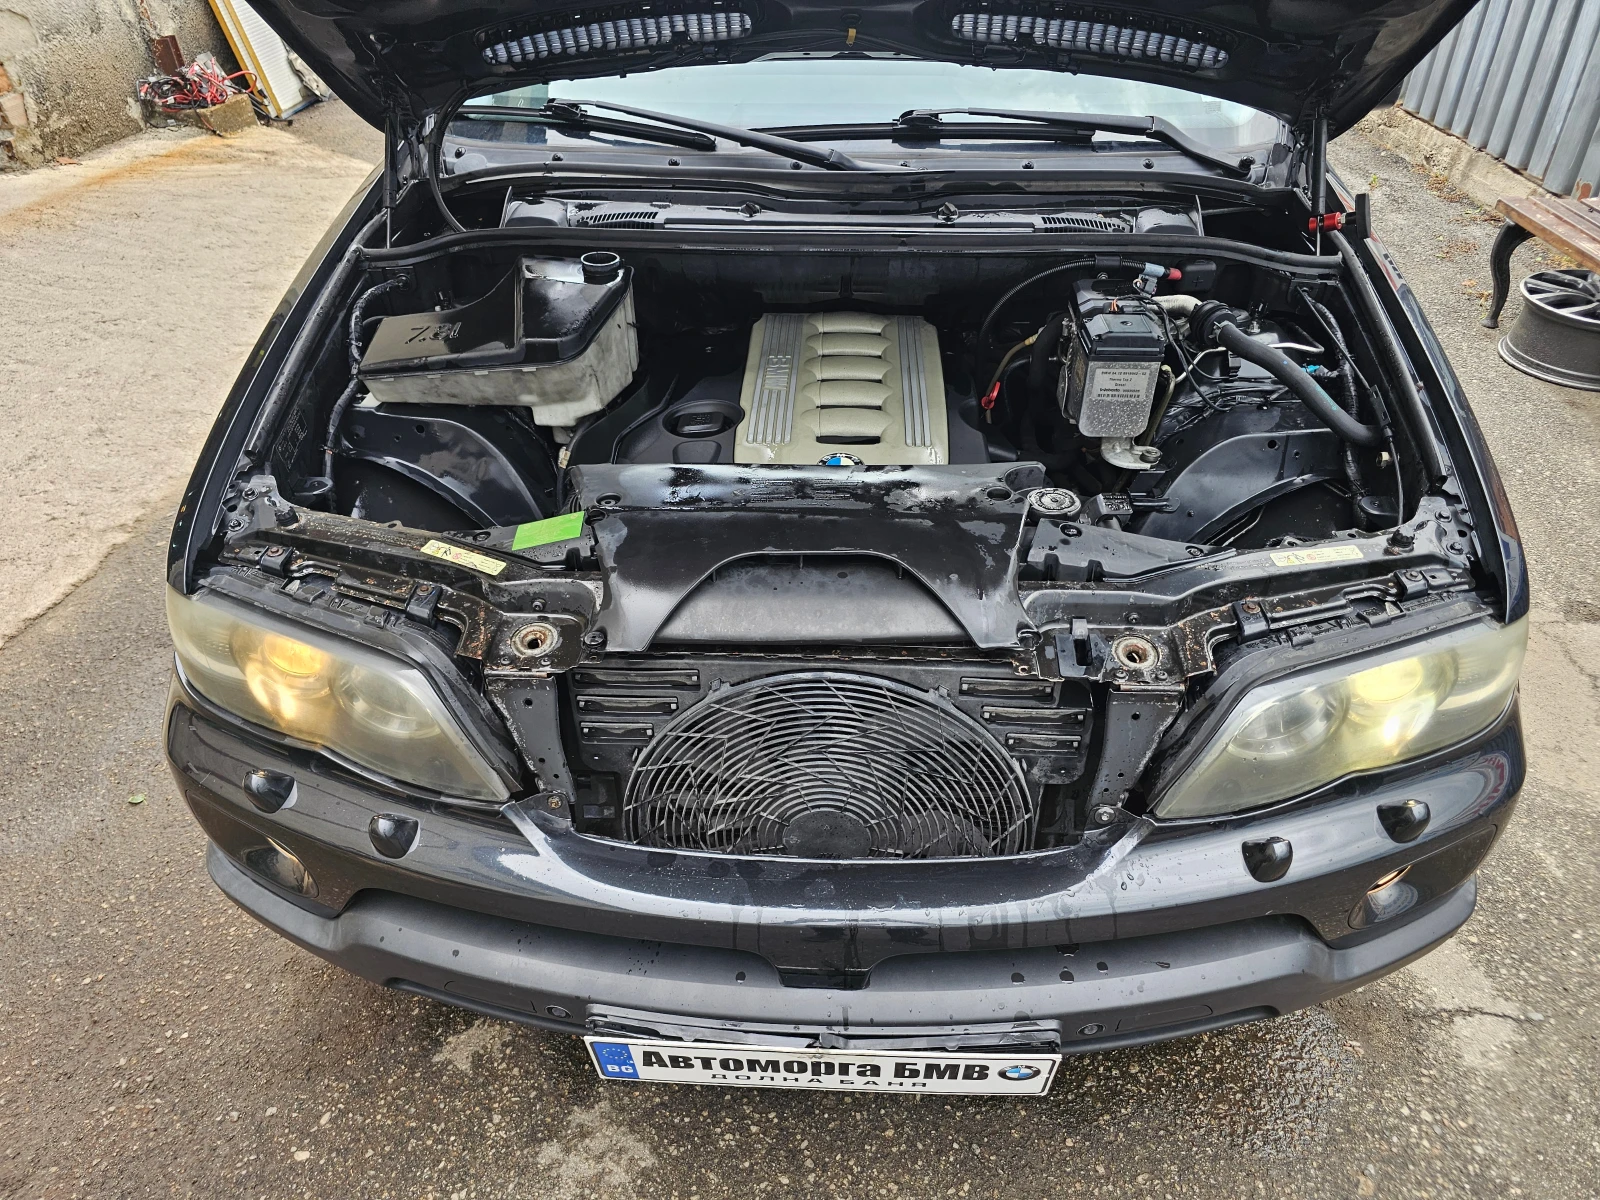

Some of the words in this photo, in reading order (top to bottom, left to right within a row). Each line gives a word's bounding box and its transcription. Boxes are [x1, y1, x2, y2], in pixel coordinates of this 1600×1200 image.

[606, 1064, 634, 1073] BG
[642, 1051, 881, 1077] Автоморга
[893, 1062, 990, 1081] БМВ
[711, 1073, 823, 1083] ДОЛНА
[839, 1079, 927, 1088] БАНЯ
